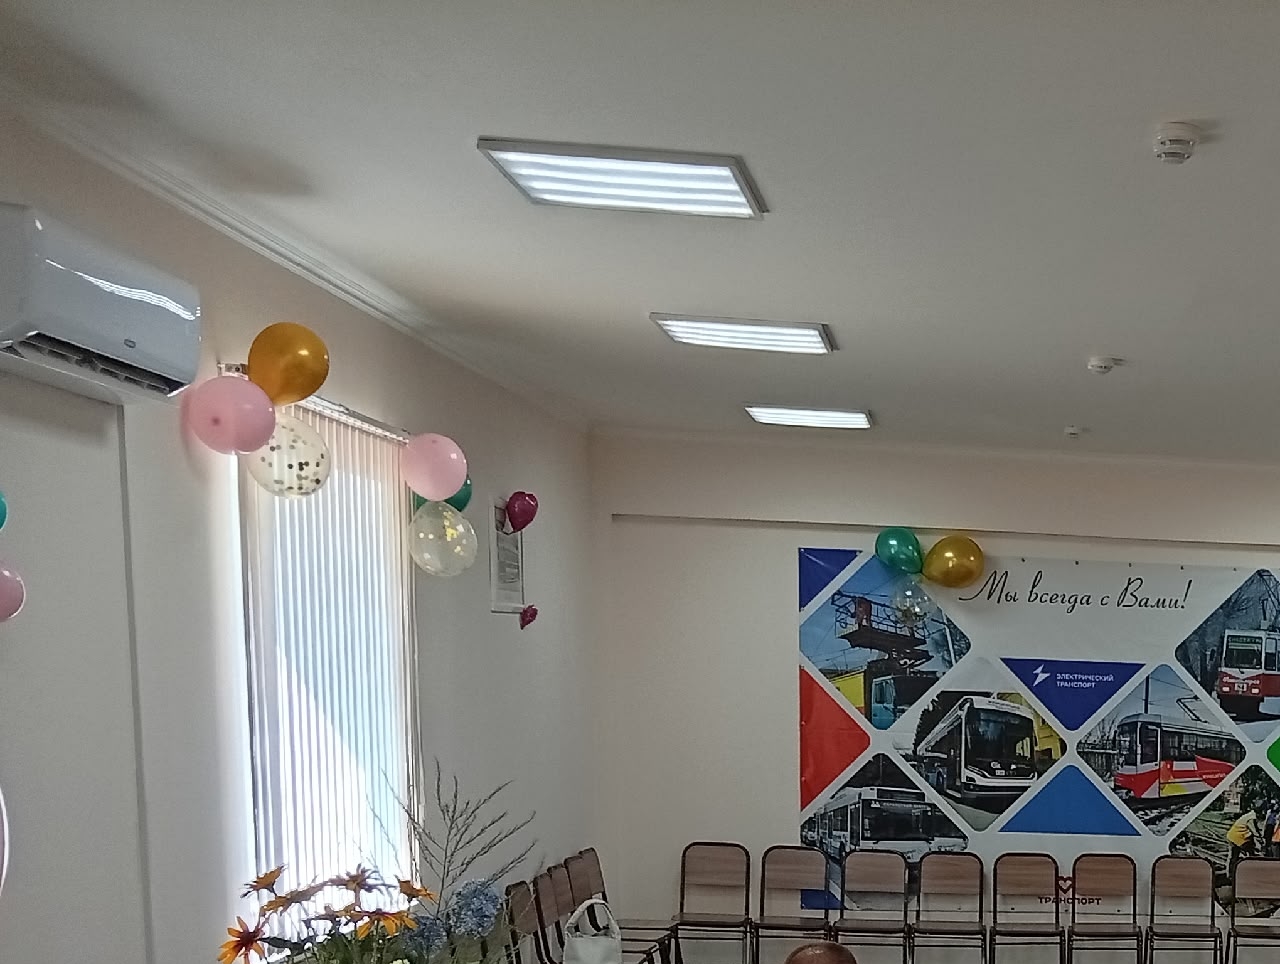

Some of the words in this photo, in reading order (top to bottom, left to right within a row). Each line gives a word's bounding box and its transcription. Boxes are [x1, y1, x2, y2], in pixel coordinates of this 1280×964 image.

[958, 570, 1019, 604] Мы
[1027, 570, 1092, 613] всегда
[1100, 594, 1110, 606] с
[1116, 577, 1193, 609] Вами!
[1056, 673, 1114, 682] ЭЛЕКТРИЧЕСКИЙ
